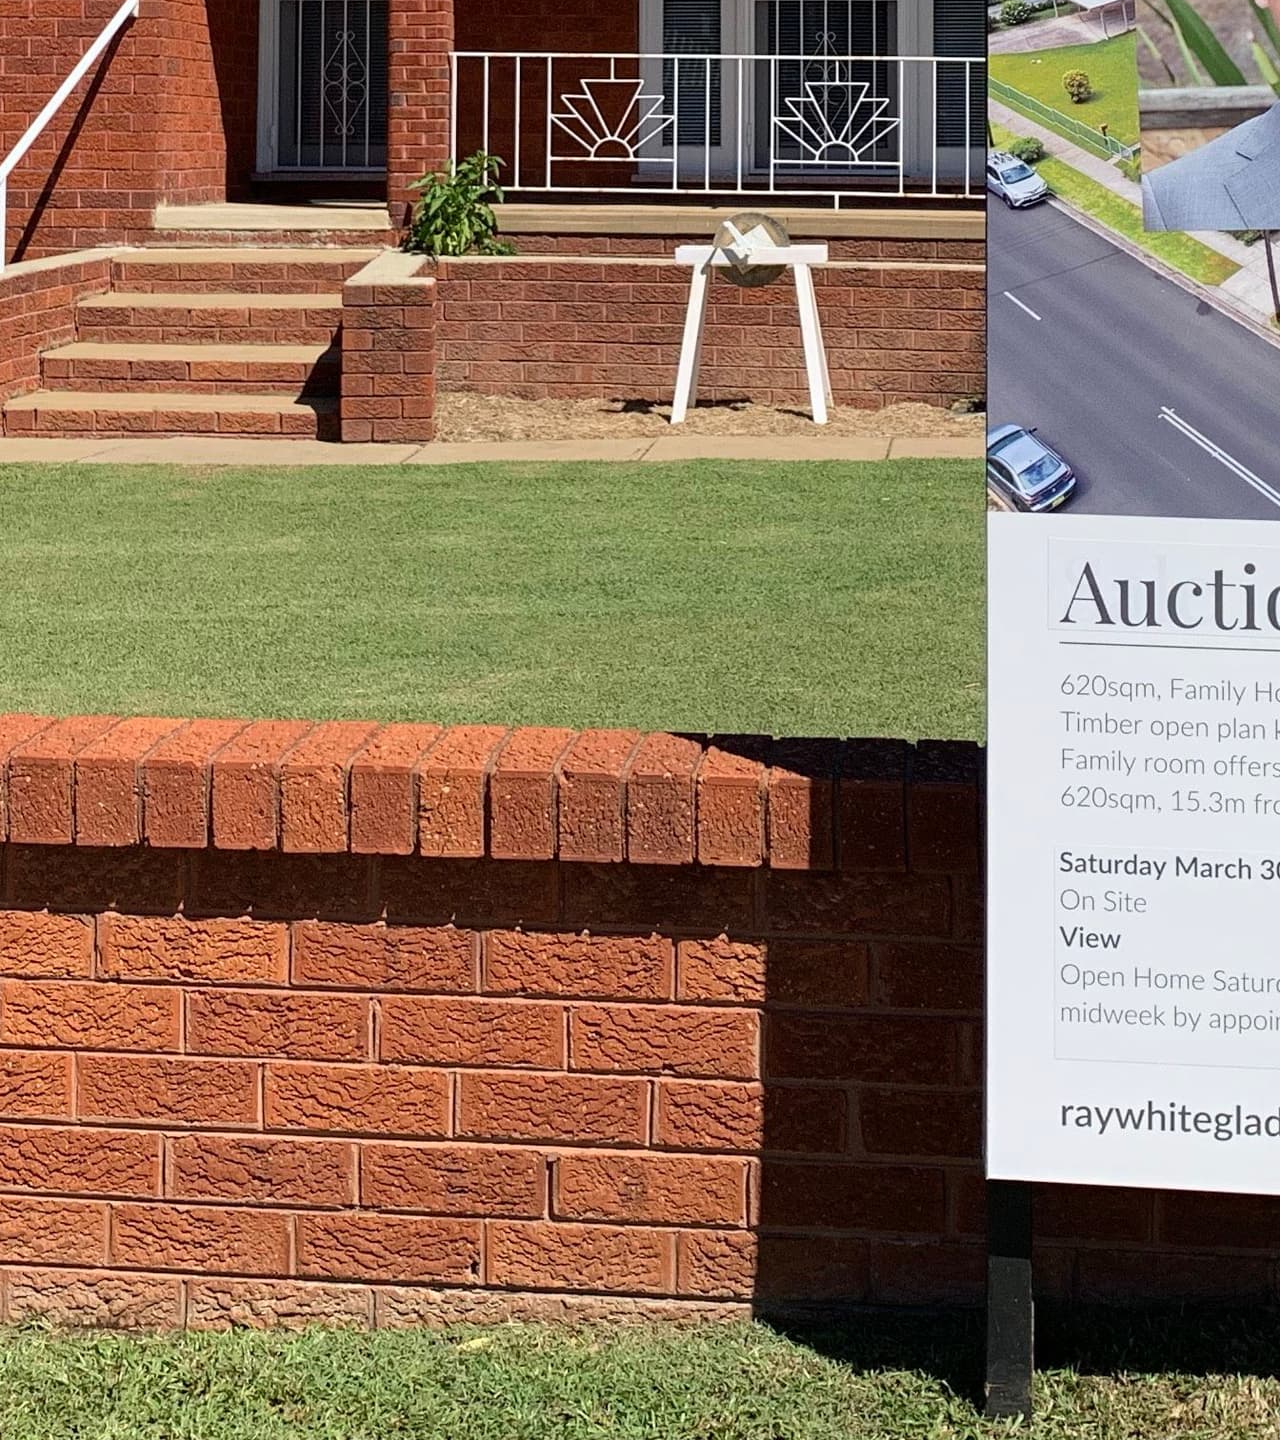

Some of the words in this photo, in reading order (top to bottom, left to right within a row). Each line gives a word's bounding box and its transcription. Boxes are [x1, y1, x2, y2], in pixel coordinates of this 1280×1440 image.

[1060, 673, 1161, 703] 620sqm,
[1170, 677, 1247, 707] Family
[1059, 710, 1144, 735] Timber
[1150, 719, 1209, 741] open
[1217, 716, 1266, 744] plan
[1061, 747, 1137, 777] Family
[1144, 756, 1205, 776] room
[1060, 785, 1162, 815] 620sqm,
[1171, 789, 1246, 815] 15.3m
[1059, 851, 1168, 881] Saturday
[1175, 855, 1252, 881] March
[1059, 888, 1096, 912] On
[1103, 890, 1147, 914] Site
[1059, 925, 1122, 949] View
[1060, 963, 1125, 991] Open
[1134, 966, 1206, 991] Home
[1060, 1001, 1166, 1027] midweek
[1173, 1004, 1202, 1033] by
